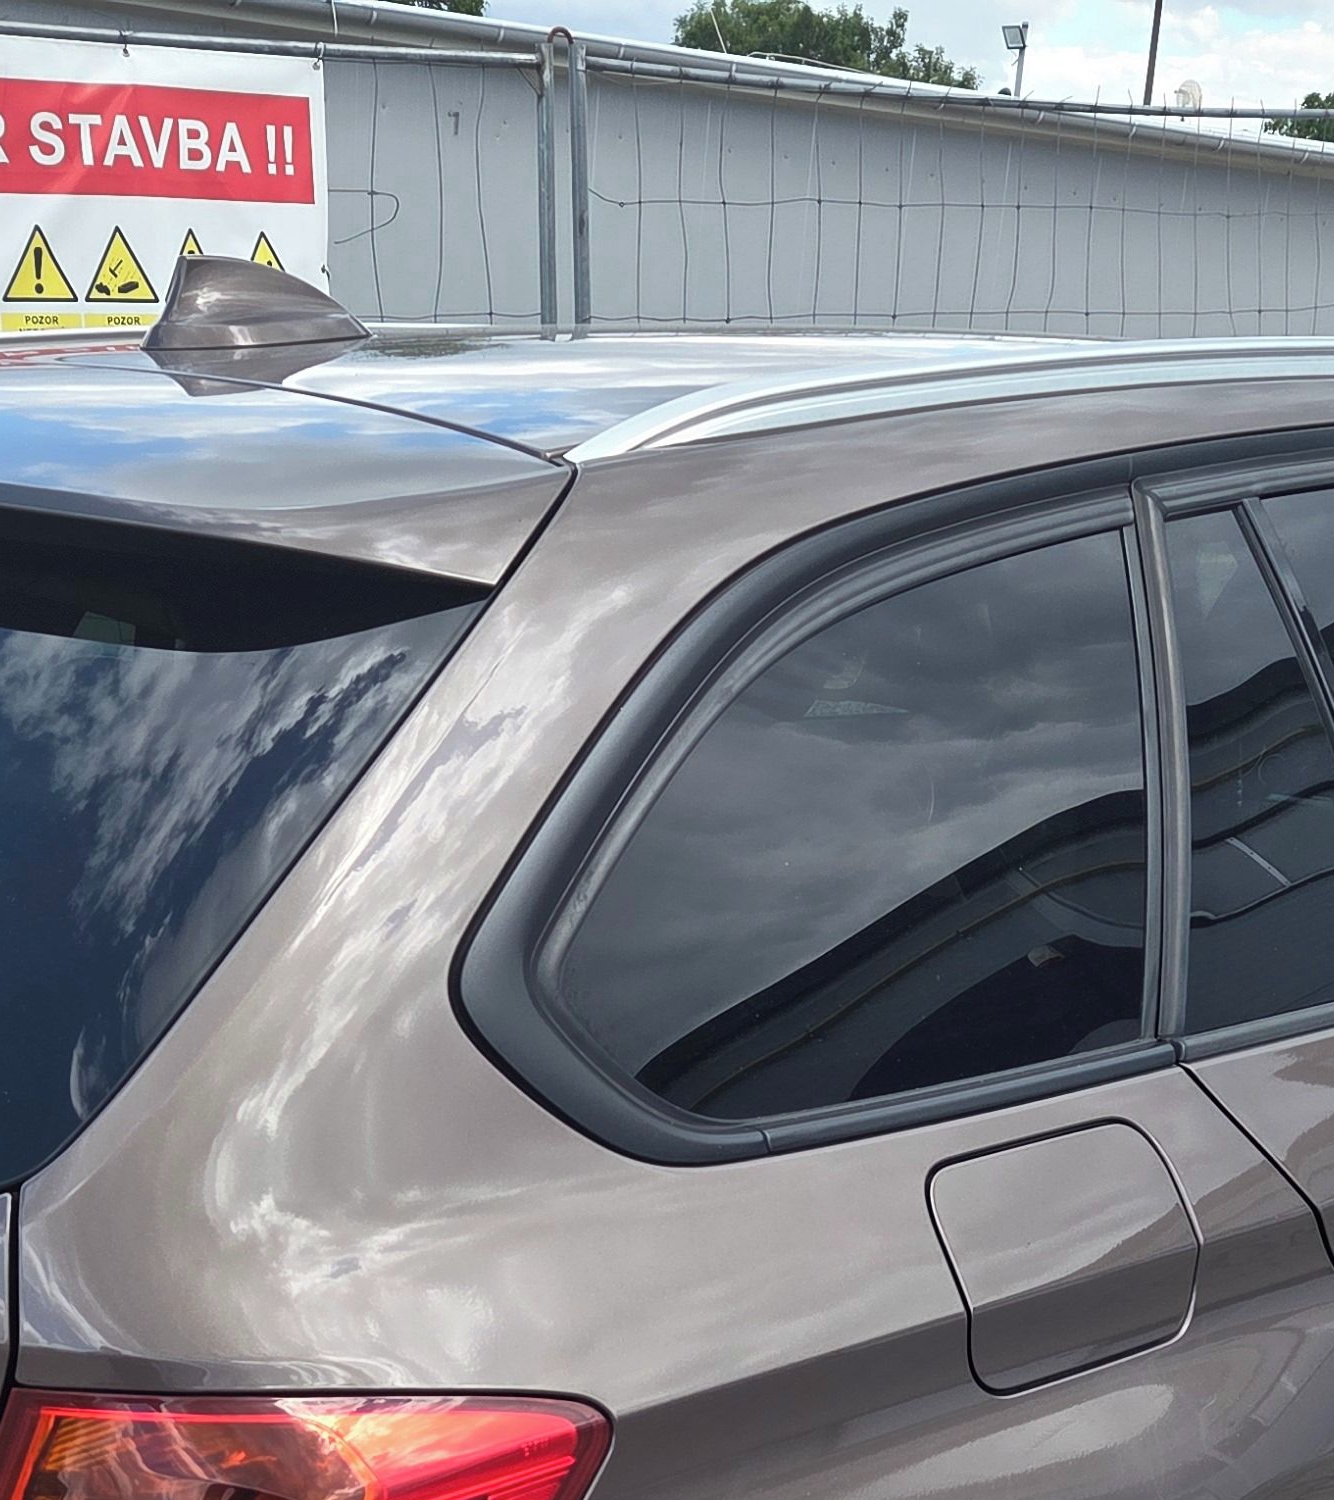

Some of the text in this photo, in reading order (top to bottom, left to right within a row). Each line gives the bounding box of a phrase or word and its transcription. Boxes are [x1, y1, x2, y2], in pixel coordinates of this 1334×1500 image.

[28, 112, 252, 174] STAVBA
[265, 124, 295, 176] !!
[24, 315, 59, 325] POZOR
[106, 316, 142, 326] POZOR
